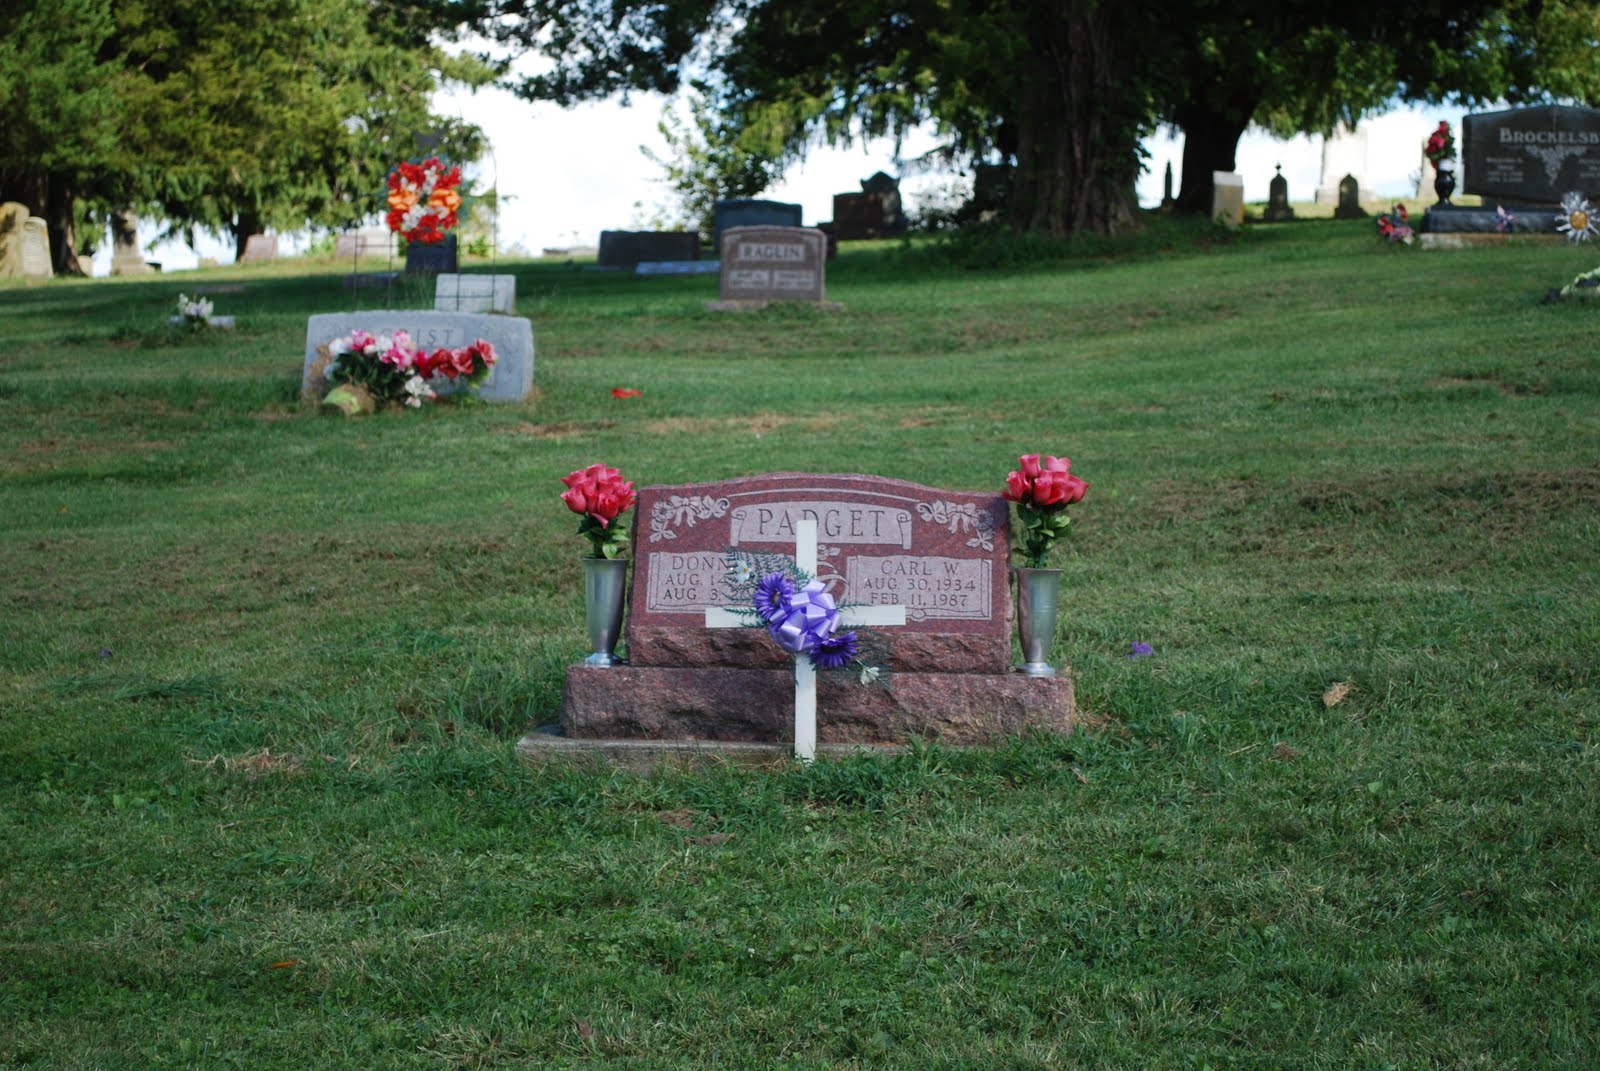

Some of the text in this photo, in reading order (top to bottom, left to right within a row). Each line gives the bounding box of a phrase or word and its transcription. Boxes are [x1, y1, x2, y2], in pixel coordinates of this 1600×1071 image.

[1499, 127, 1600, 144] BROCKELSB
[743, 245, 801, 258] RAGLIN
[757, 508, 885, 537] PADGET
[671, 555, 742, 571] DONN
[881, 560, 960, 576] CARL W.
[863, 577, 976, 592] AUG. 30, 1934
[932, 594, 968, 607] 1987
